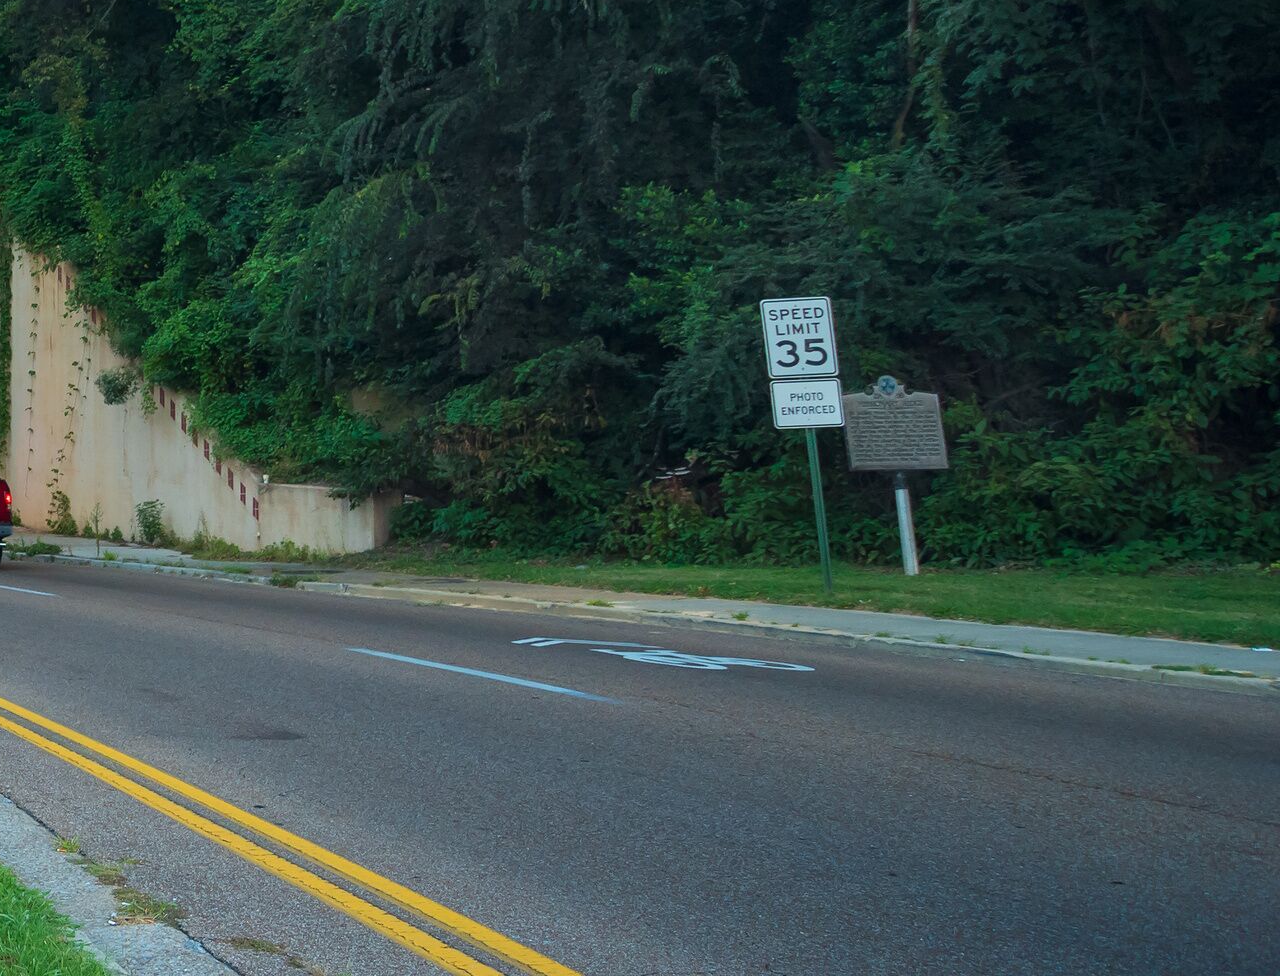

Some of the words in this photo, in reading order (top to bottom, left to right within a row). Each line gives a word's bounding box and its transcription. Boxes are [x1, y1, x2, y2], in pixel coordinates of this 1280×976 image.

[768, 307, 824, 321] SPEED
[775, 322, 821, 336] LIMIT
[775, 337, 828, 368] 35
[790, 392, 824, 402] PHOTO
[781, 405, 836, 416] ENFORCED
